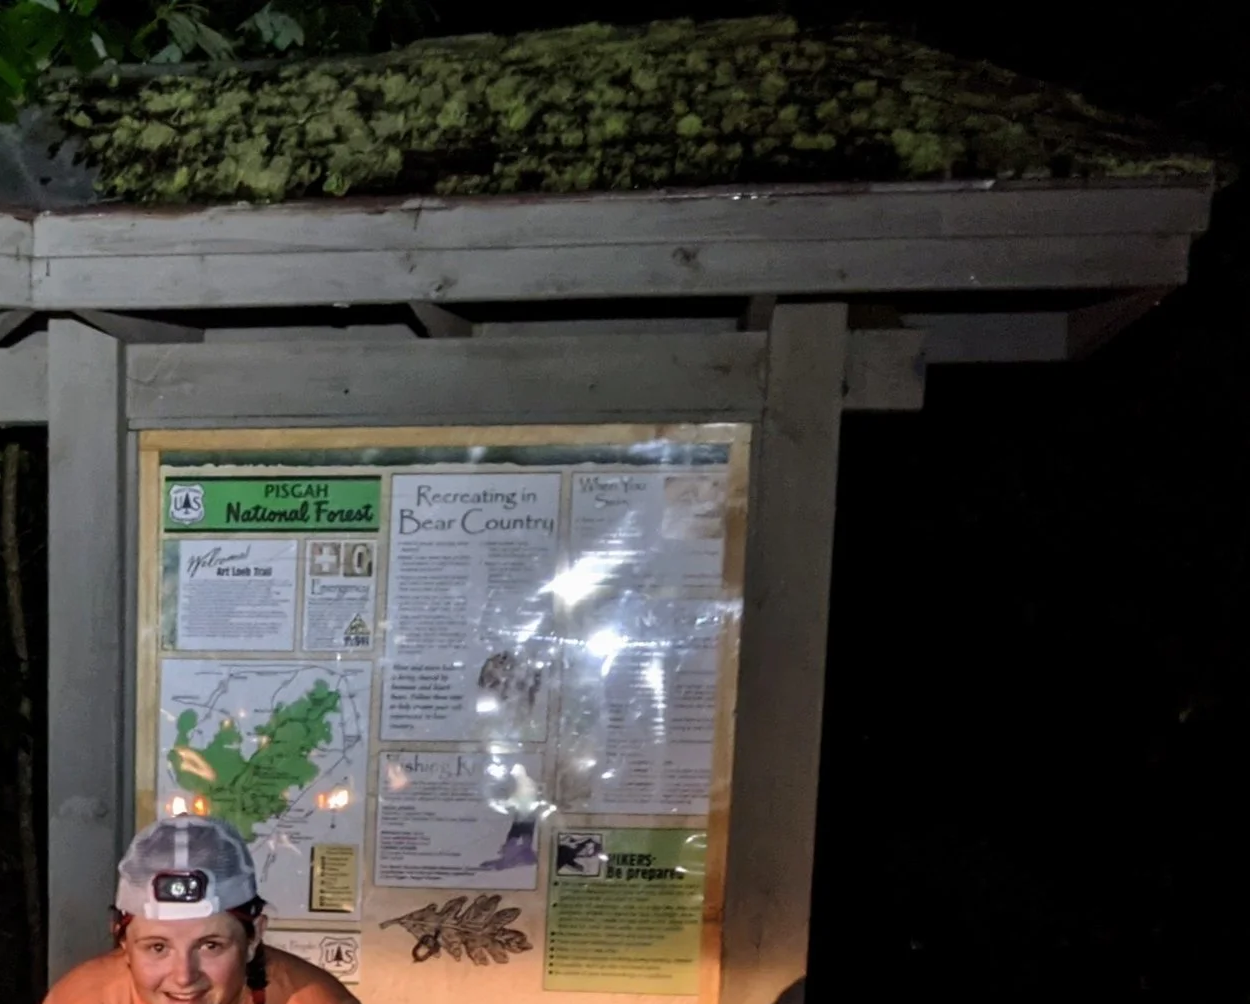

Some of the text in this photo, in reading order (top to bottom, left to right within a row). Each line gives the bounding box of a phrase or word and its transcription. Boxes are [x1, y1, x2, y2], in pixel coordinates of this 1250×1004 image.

[264, 484, 329, 498] PISGAH
[416, 484, 537, 510] Recreating in
[226, 500, 374, 524] National Forest
[398, 508, 457, 535] Bear
[460, 507, 555, 536] Country
